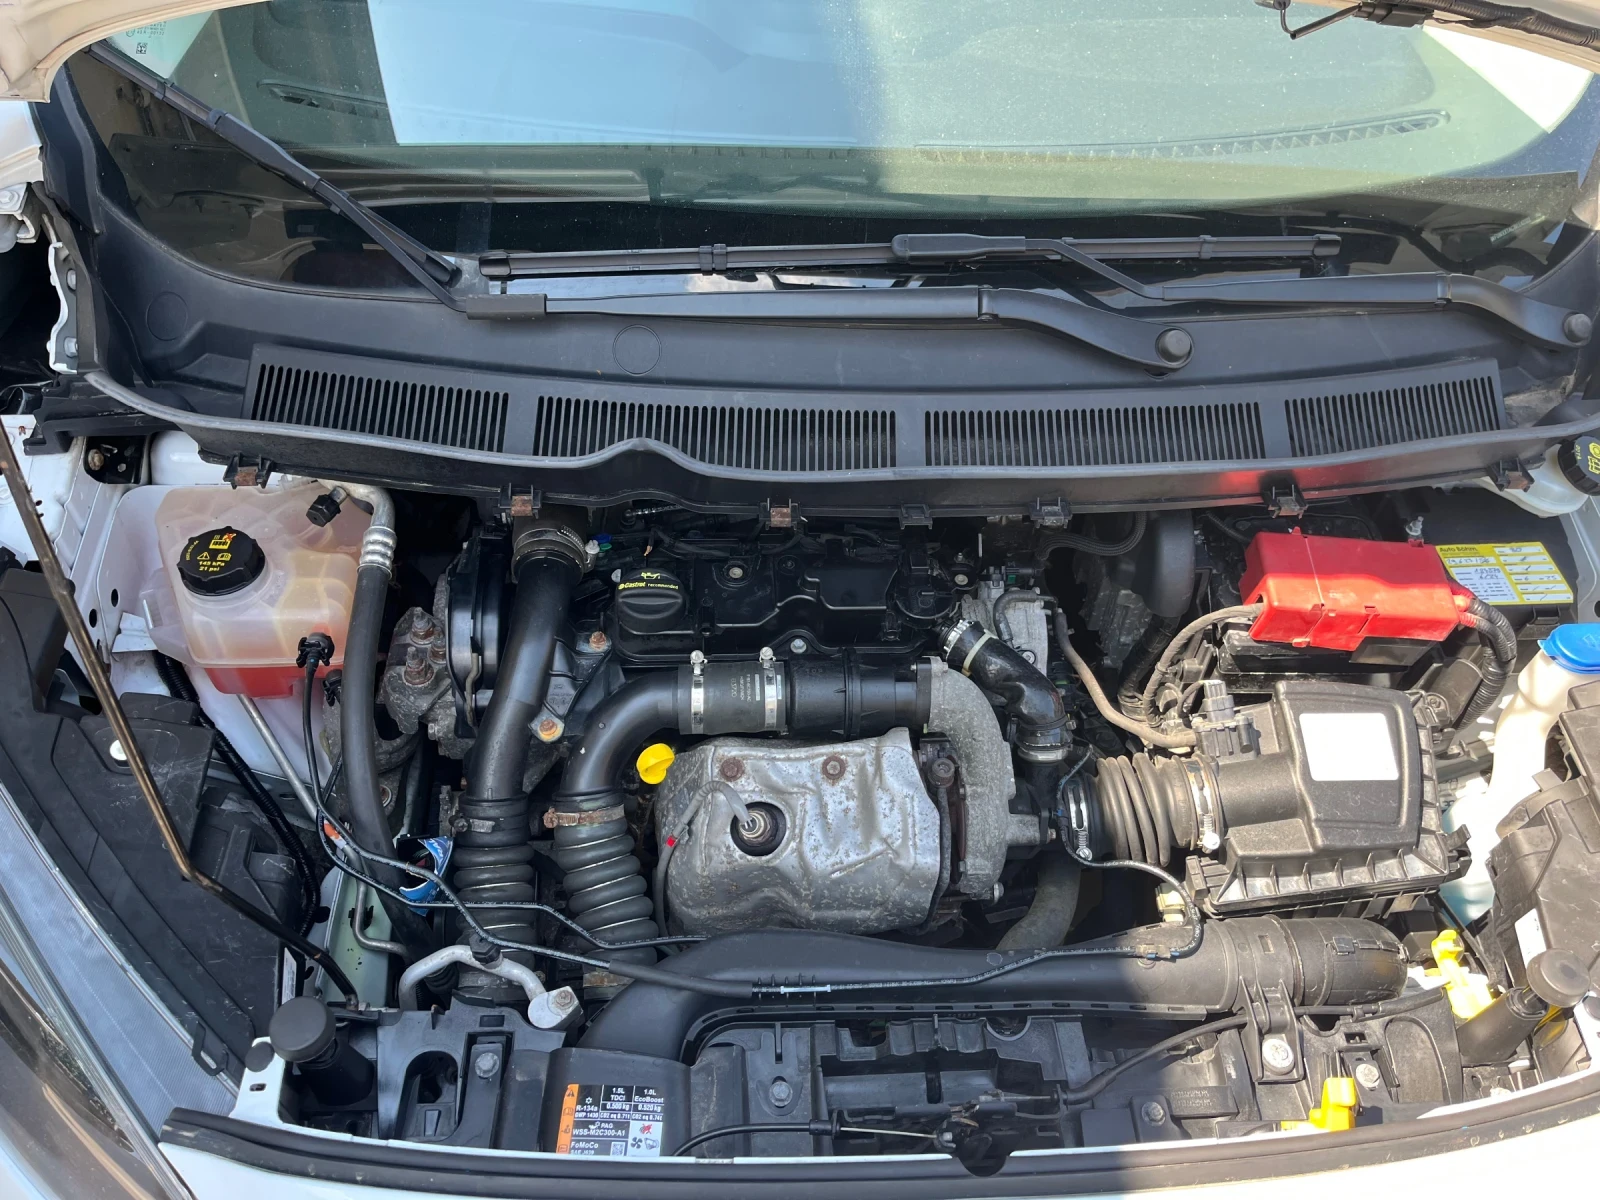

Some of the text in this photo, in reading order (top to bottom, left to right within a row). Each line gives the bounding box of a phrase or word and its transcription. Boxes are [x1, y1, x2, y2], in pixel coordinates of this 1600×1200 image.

[634, 1095, 664, 1103] EcoBoost
[622, 1103, 630, 1111] kg
[570, 1141, 599, 1149] FoMoCo
